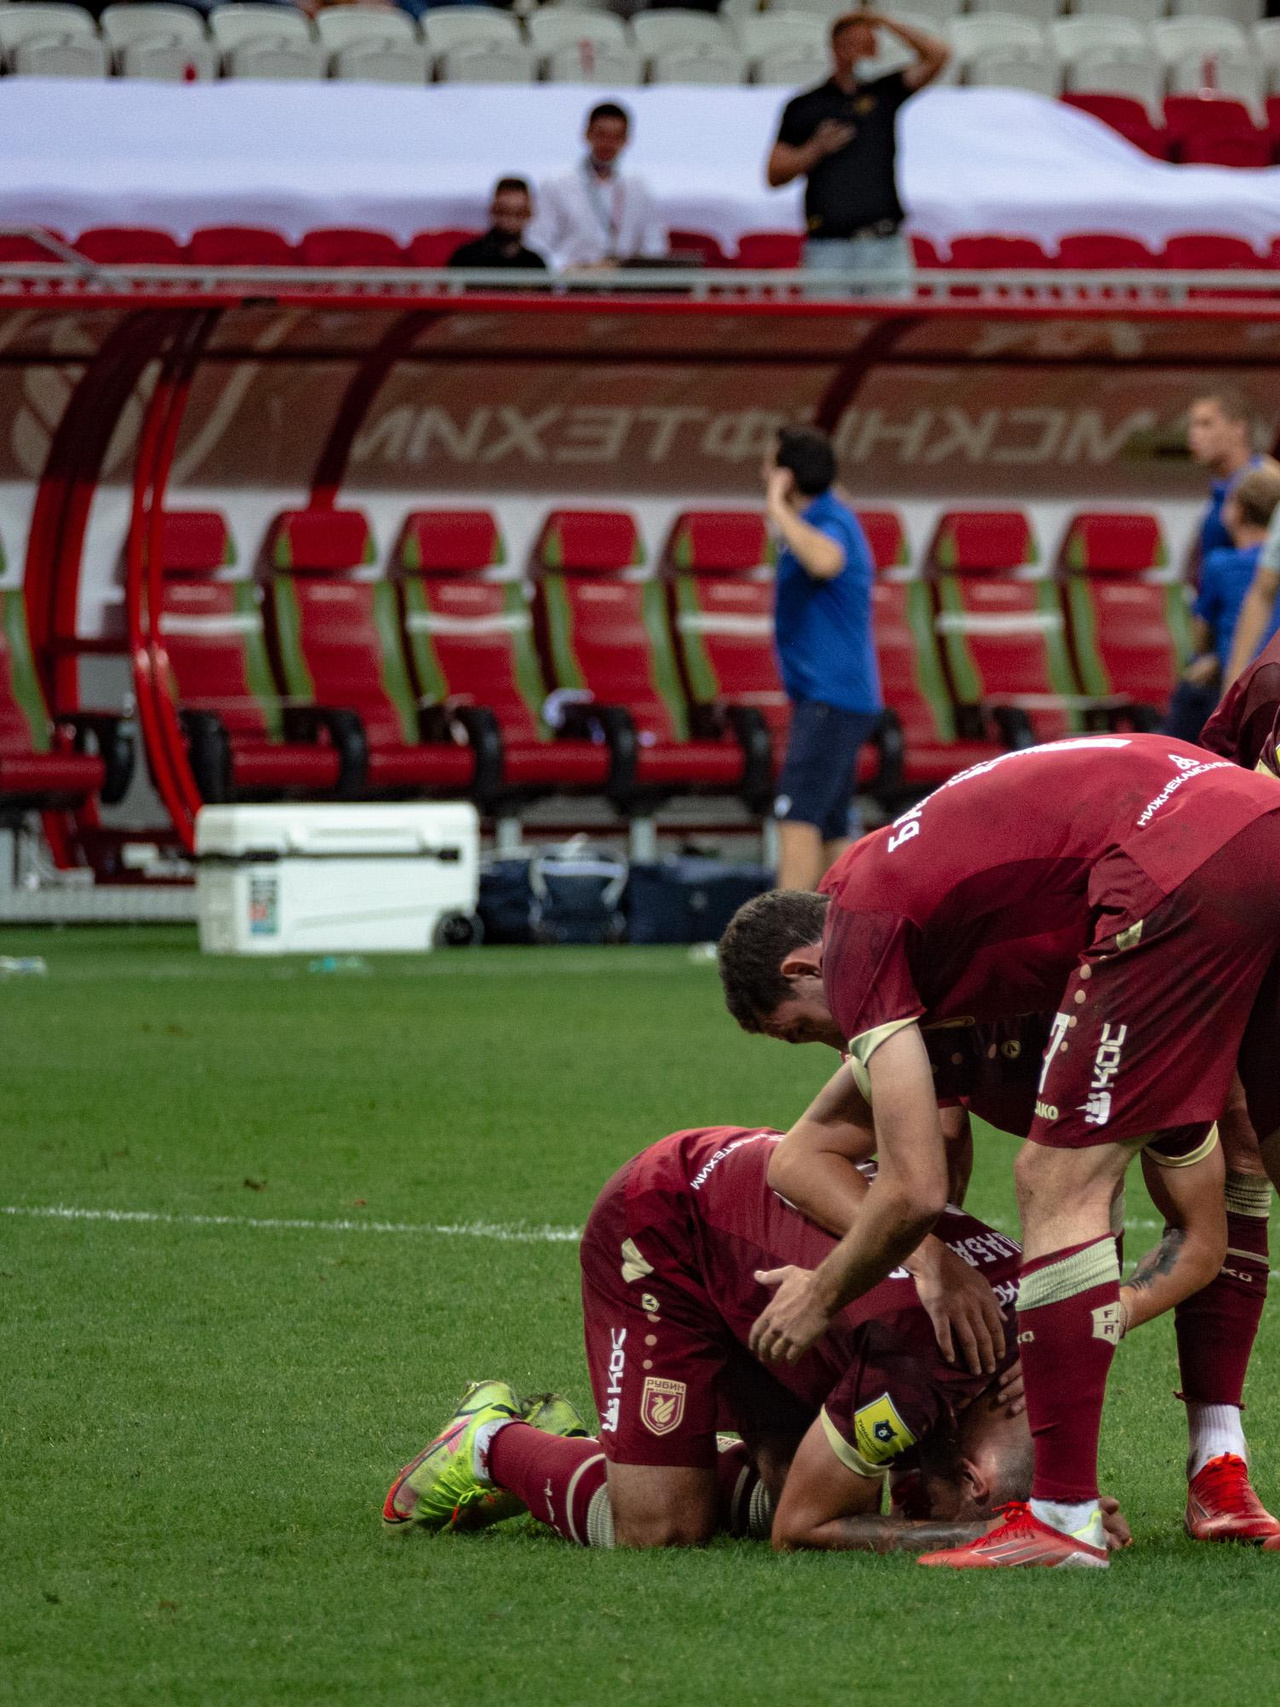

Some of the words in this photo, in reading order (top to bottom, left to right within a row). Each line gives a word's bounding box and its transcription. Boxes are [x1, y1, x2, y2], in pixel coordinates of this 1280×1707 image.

[1091, 1023, 1128, 1088] КОС
[607, 1328, 627, 1394] КОС
[646, 1379, 686, 1392] РУБИН
